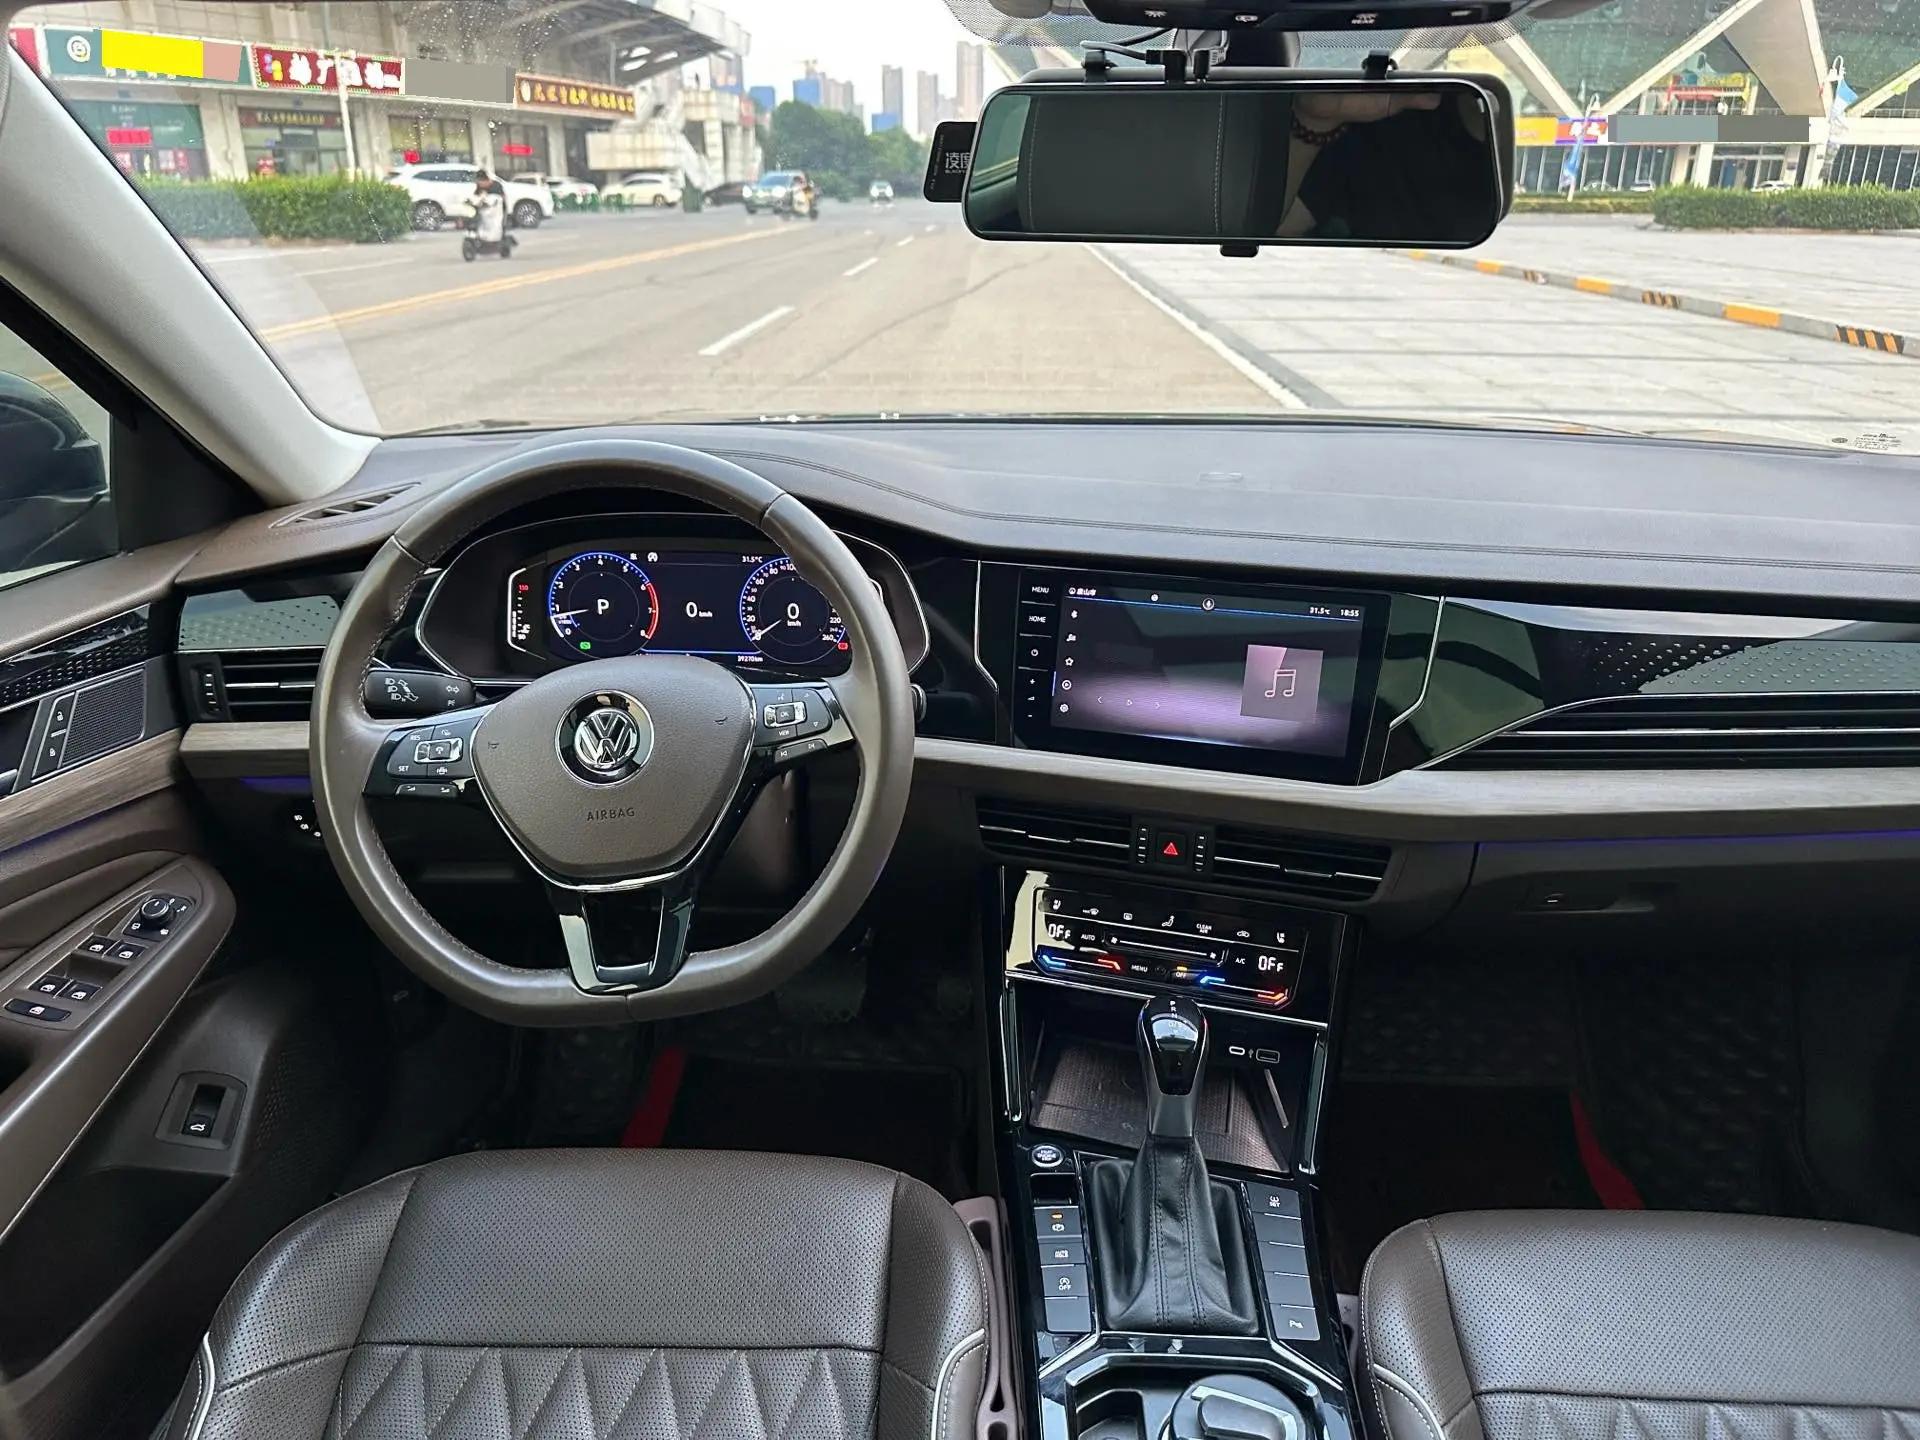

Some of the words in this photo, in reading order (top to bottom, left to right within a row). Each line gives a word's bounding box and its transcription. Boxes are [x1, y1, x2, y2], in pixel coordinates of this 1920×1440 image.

[1031, 586, 1050, 594] MENU
[597, 599, 610, 614] P
[686, 601, 698, 618] 0
[787, 603, 800, 619] 0
[1028, 615, 1047, 623] HOME
[586, 807, 635, 822] AIRBAG
[1081, 933, 1096, 941] AUTO
[1131, 964, 1148, 973] MENU
